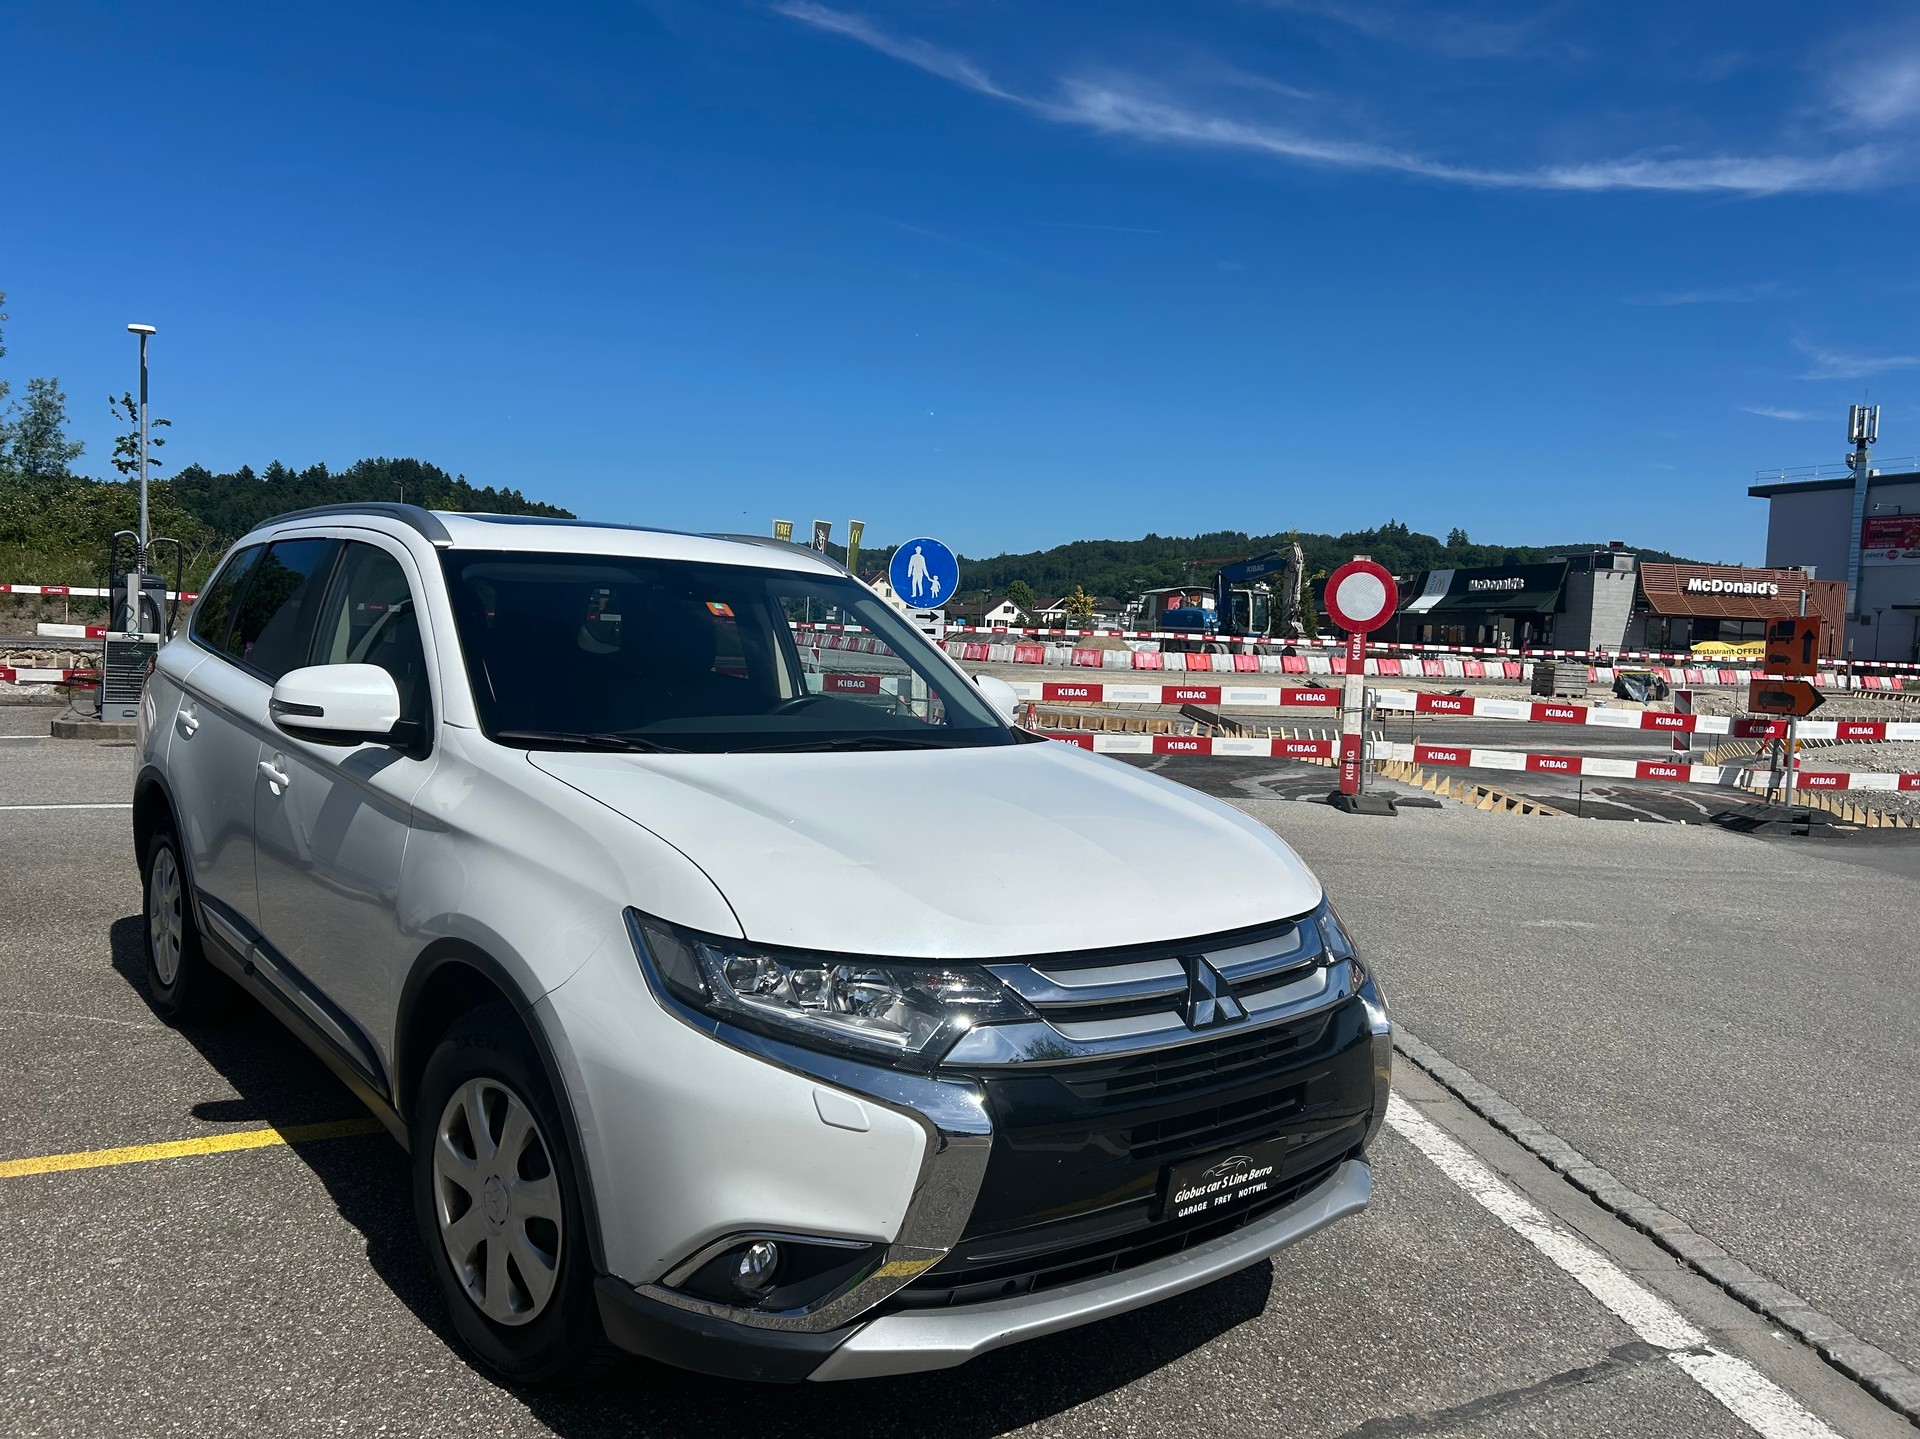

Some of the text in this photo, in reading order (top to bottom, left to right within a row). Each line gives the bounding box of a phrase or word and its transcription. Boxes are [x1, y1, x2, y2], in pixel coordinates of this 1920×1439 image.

[776, 523, 791, 535] FREE
[1687, 578, 1779, 595] McDonald's
[837, 679, 866, 688] KIBAG
[1057, 688, 1088, 697] KIBAG
[1176, 690, 1207, 699] KIBAG
[1295, 693, 1326, 702] KIBAG
[1431, 700, 1461, 710] KIBAG
[1545, 708, 1574, 718] KIBAG
[1655, 717, 1684, 726] KIBAG
[1749, 725, 1776, 734] KIBAG
[1848, 727, 1874, 735] KIBAG
[1167, 741, 1197, 750] KIBAG
[1286, 744, 1317, 753] KIBAG
[1427, 751, 1457, 761] KIBAG
[1345, 750, 1355, 780] KIBAG
[1539, 759, 1568, 769] KIBAG
[1649, 767, 1677, 777] KIBAG
[1810, 777, 1837, 785] KIBAG
[1174, 1165, 1273, 1203] Globus car S Line Berro
[1178, 1182, 1268, 1217] GARAGE FREY NOTTWIL
